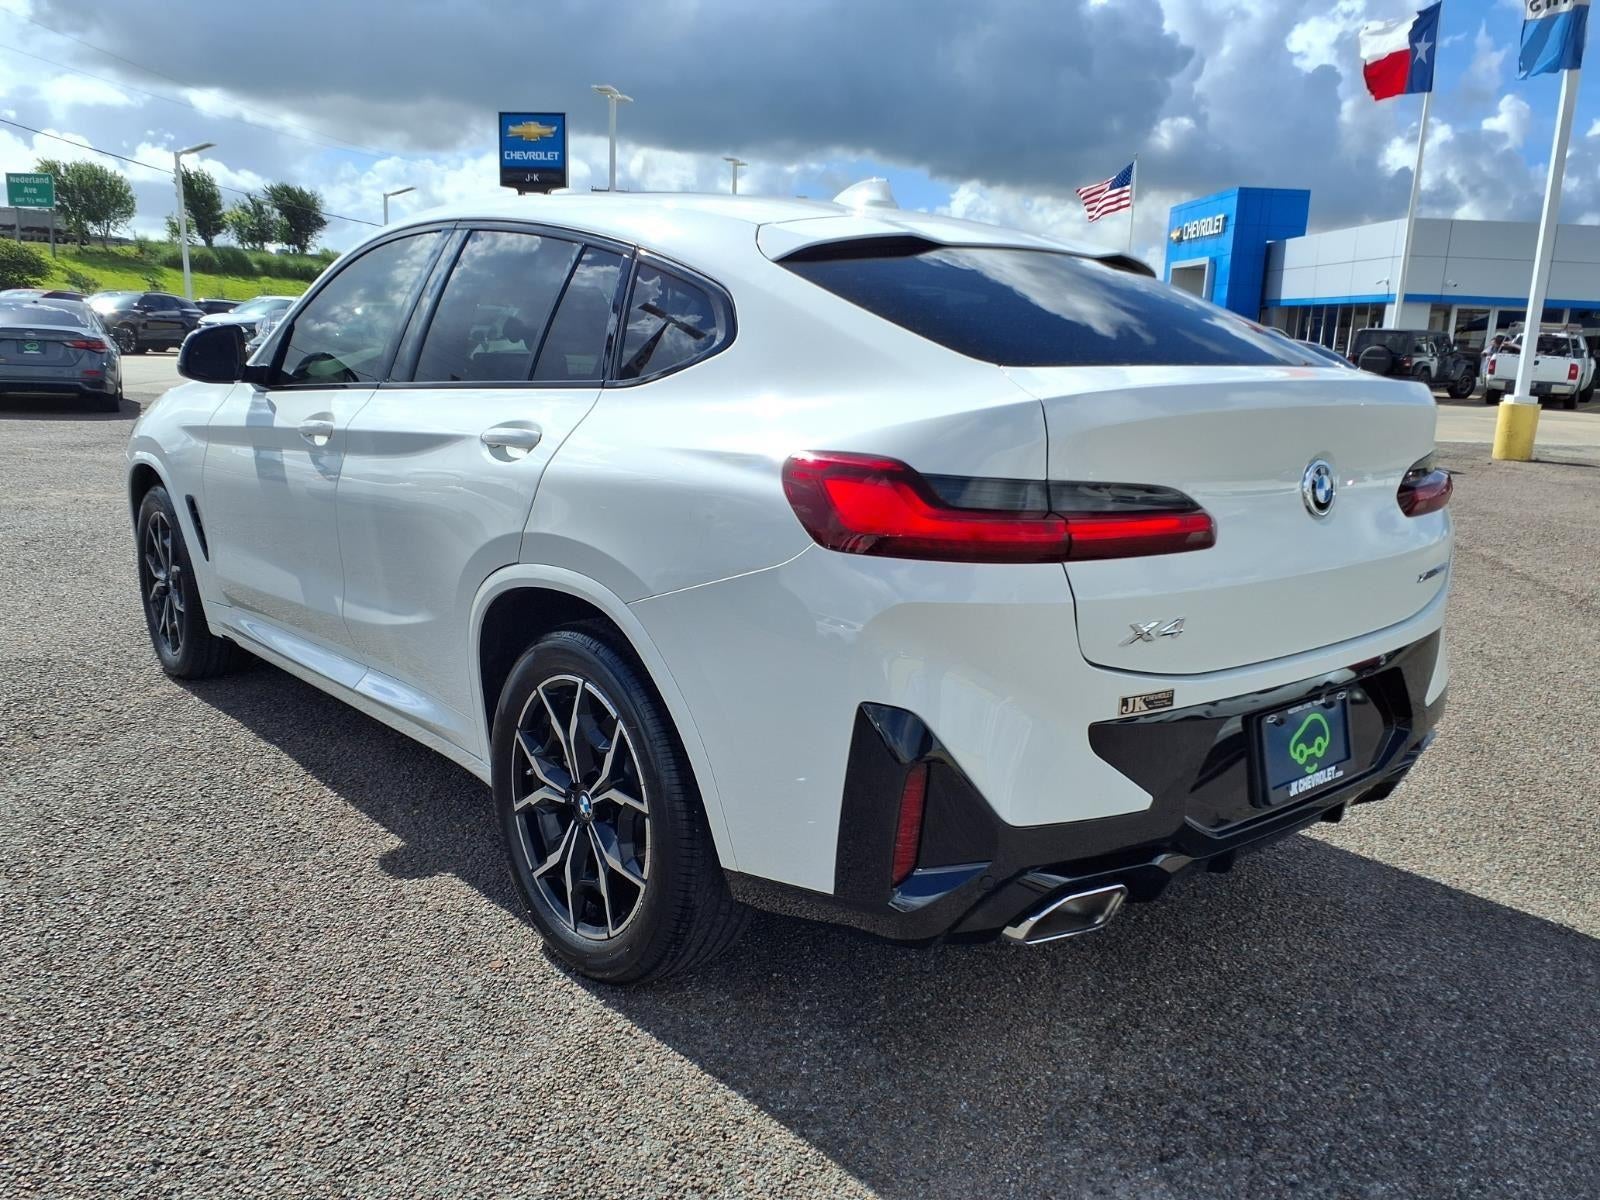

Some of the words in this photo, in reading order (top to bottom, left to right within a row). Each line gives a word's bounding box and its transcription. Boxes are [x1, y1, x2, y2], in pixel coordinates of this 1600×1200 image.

[504, 151, 560, 161] CHEVROLET
[9, 176, 49, 184] Nederland
[23, 186, 38, 194] Ave
[1182, 213, 1225, 240] CHEVROLET
[1118, 616, 1185, 647] X4
[1121, 695, 1149, 714] JK
